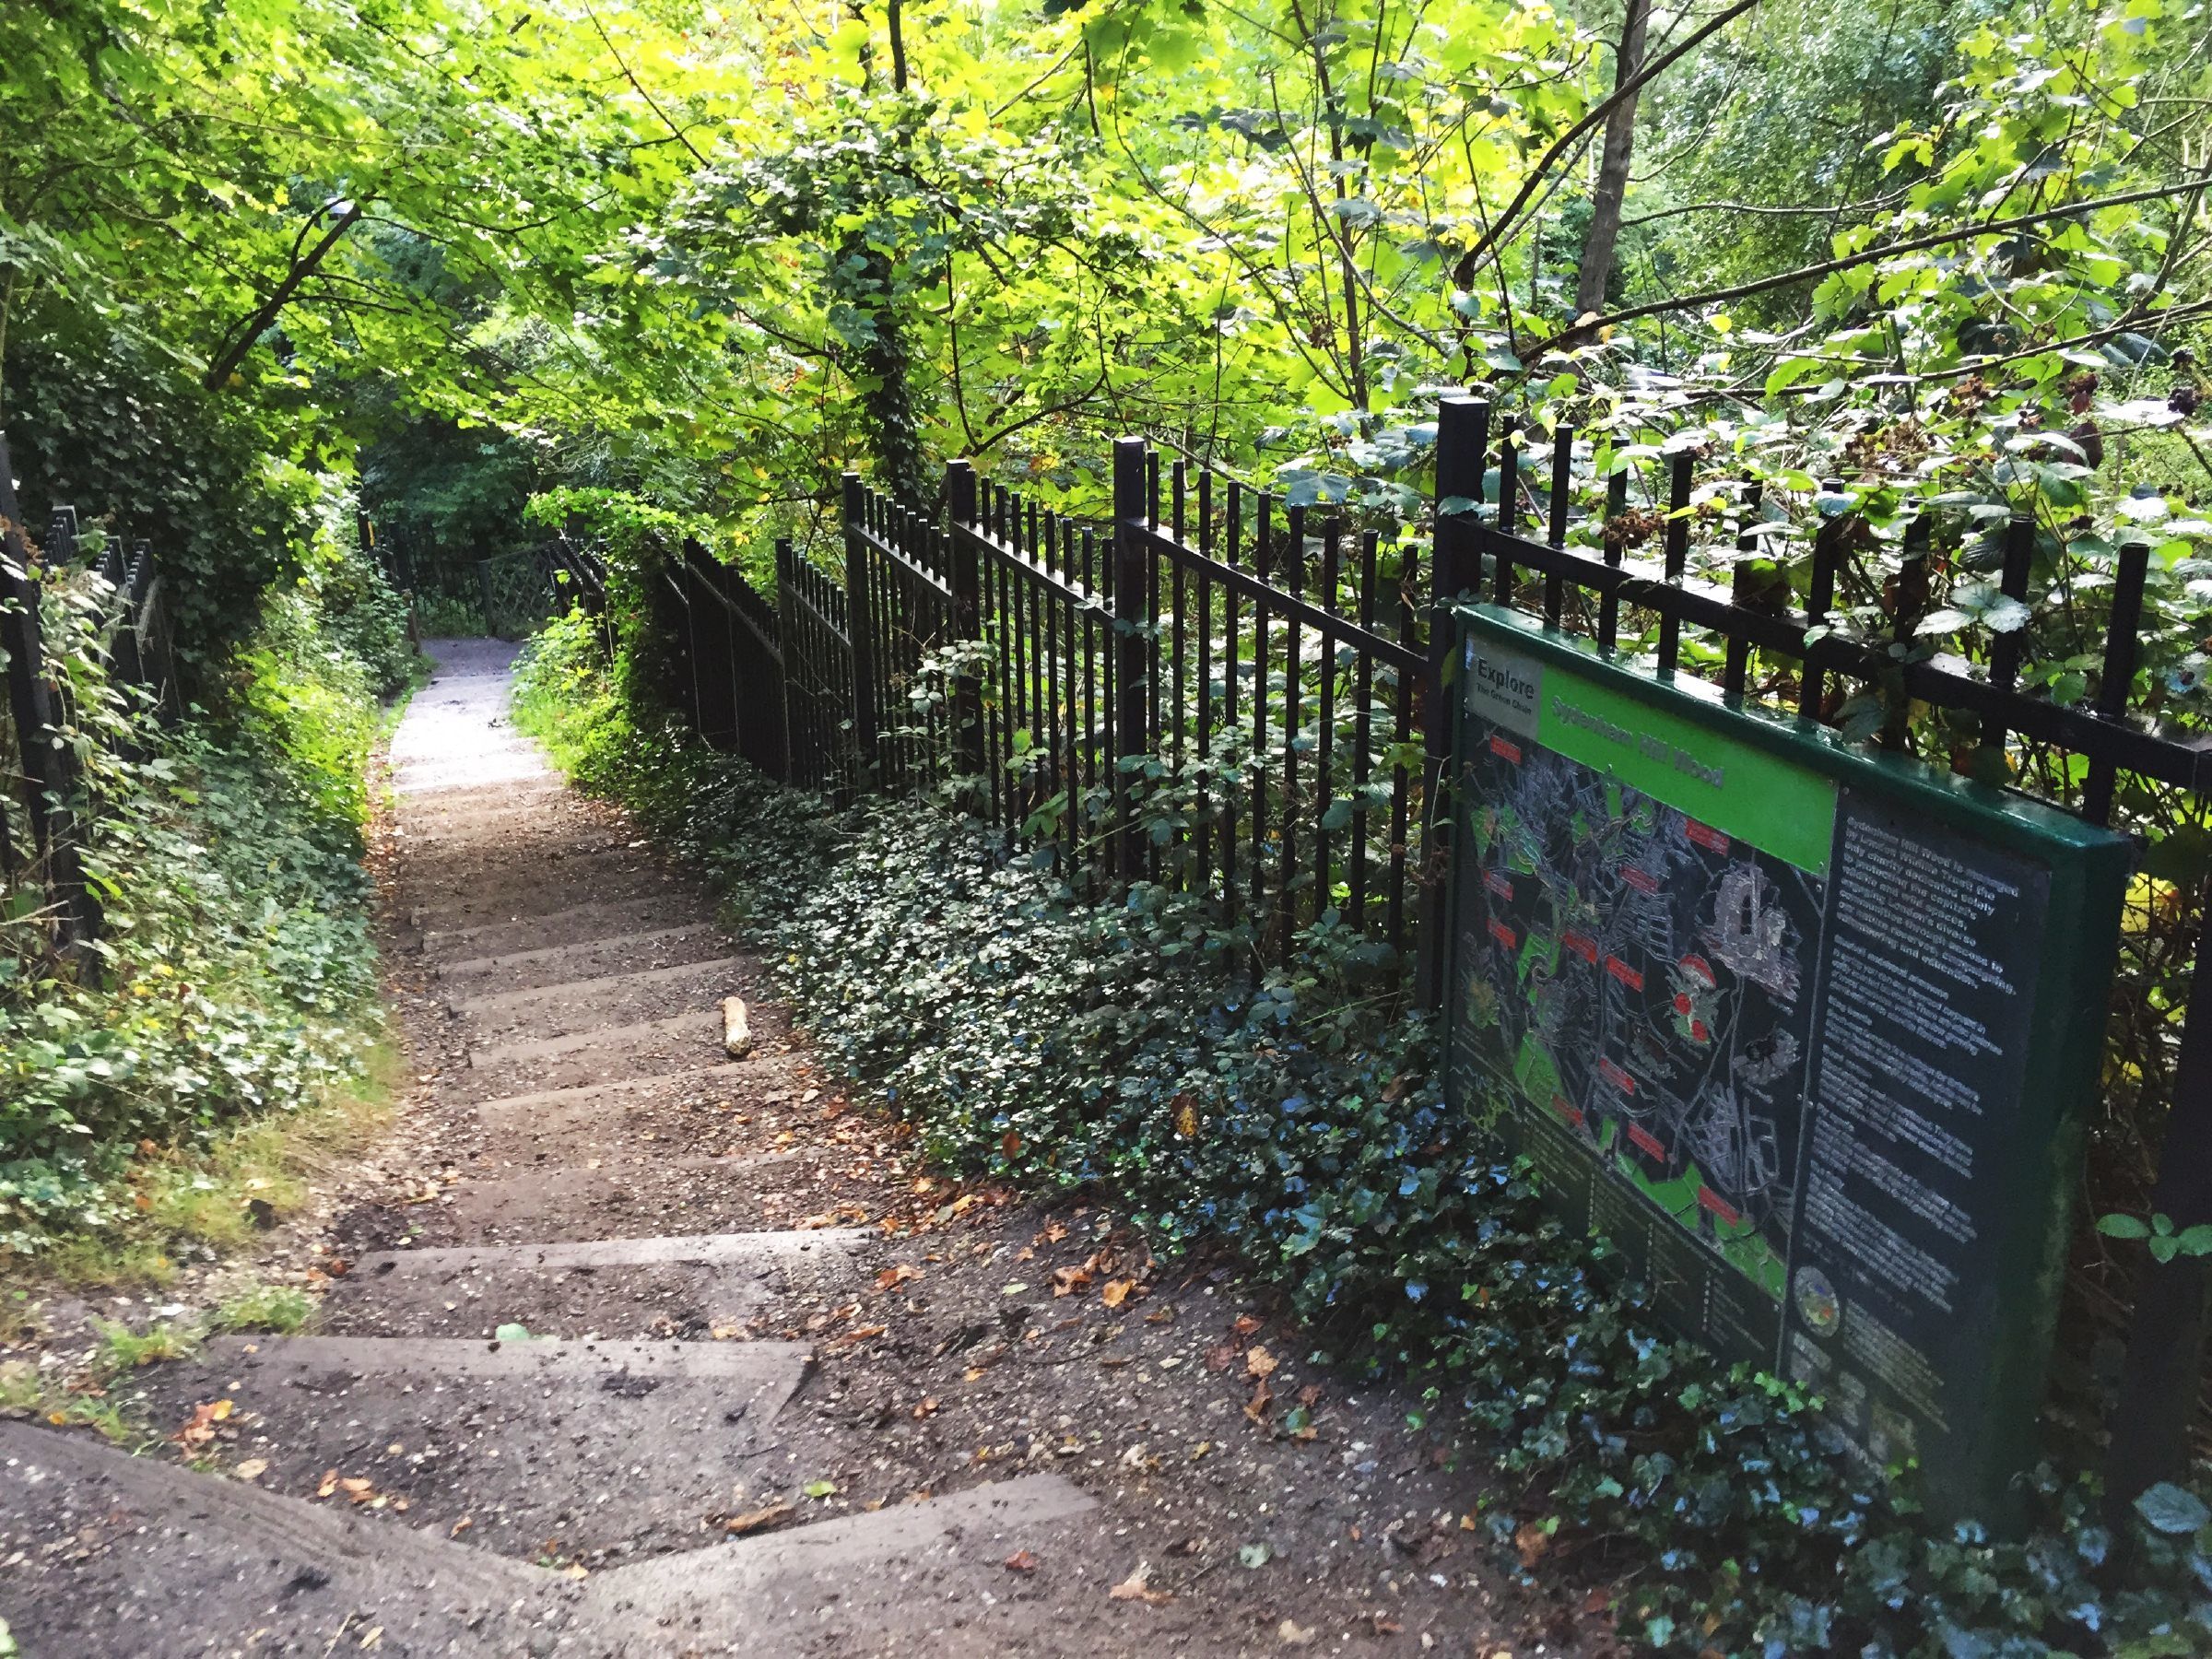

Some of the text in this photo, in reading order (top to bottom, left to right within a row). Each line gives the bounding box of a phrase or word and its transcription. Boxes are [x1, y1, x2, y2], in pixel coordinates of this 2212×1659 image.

[1477, 658, 1534, 700] Explore
[1476, 682, 1533, 716] The Green Chain
[1900, 838, 1918, 854] Hill
[1921, 847, 1950, 868] Wood
